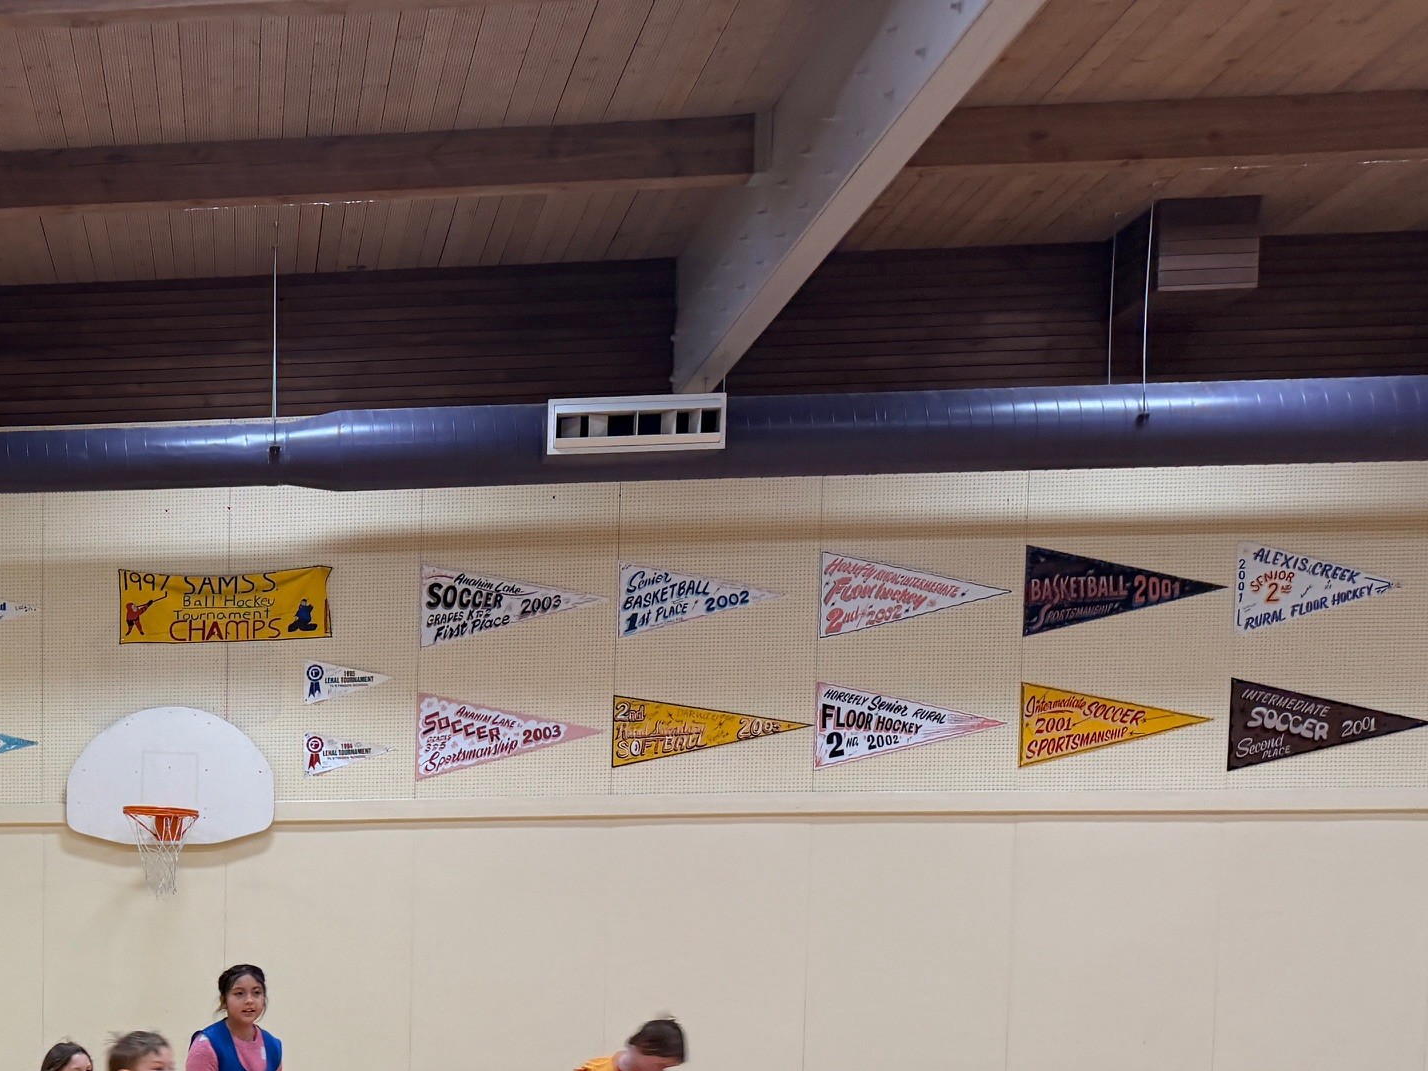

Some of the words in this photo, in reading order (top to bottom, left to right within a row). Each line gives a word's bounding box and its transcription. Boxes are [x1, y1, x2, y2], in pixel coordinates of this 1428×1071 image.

[1253, 548, 1308, 571] ALEXIS
[1311, 562, 1360, 584] CREEK
[123, 571, 170, 591] 1997
[454, 573, 494, 589] Anahim
[495, 582, 524, 593] Lake
[626, 571, 672, 593] Senior
[1030, 574, 1128, 600] BASKETBALL
[1133, 575, 1181, 603] 2001
[1250, 570, 1295, 592] SENIOR
[183, 595, 215, 607] Ball
[224, 594, 275, 608] Hockey
[426, 583, 504, 609] SOCCER
[521, 595, 562, 617] 2003
[623, 580, 710, 610] BASKETBALL
[705, 590, 750, 612] 2002
[1244, 608, 1286, 630] RURAL
[1291, 597, 1329, 617] FLOOR
[1331, 584, 1373, 605] HOCKEY
[173, 609, 270, 621] Tournament
[426, 611, 464, 627] GRADES
[467, 610, 474, 620] K
[484, 609, 492, 617] 2
[624, 611, 651, 632] 1st
[655, 603, 688, 622] PLACE
[866, 605, 902, 625] 2002
[1032, 603, 1112, 629] SPORTSMANSHIP
[169, 618, 282, 641] CHAMPS
[434, 622, 468, 642] First
[471, 615, 510, 633] Place
[615, 701, 646, 722] 2nd
[824, 689, 869, 706] HORSEFLY
[867, 695, 908, 717] Senior
[912, 708, 947, 724] RURAL
[1024, 695, 1086, 718] Intermediate
[1083, 701, 1146, 726] SOCCER
[1241, 688, 1331, 717] INTERMEDIATE
[422, 711, 501, 742] SOCCER
[523, 725, 562, 744] 2003
[456, 706, 492, 723] ANAHIM
[492, 714, 516, 729] LAKE
[822, 704, 873, 730] FLOOR
[876, 715, 922, 734] HOCKEY
[1035, 717, 1072, 734] 2001
[1247, 706, 1329, 741] SOCCER
[1341, 717, 1376, 738] 2001
[616, 734, 707, 758] SOFTBALL
[867, 735, 899, 750] 2002
[1026, 727, 1128, 759] SPORTSMANSHIP
[1236, 734, 1284, 758] Second
[1262, 745, 1291, 759] PLACE
[423, 738, 518, 772] Sportsmanship
